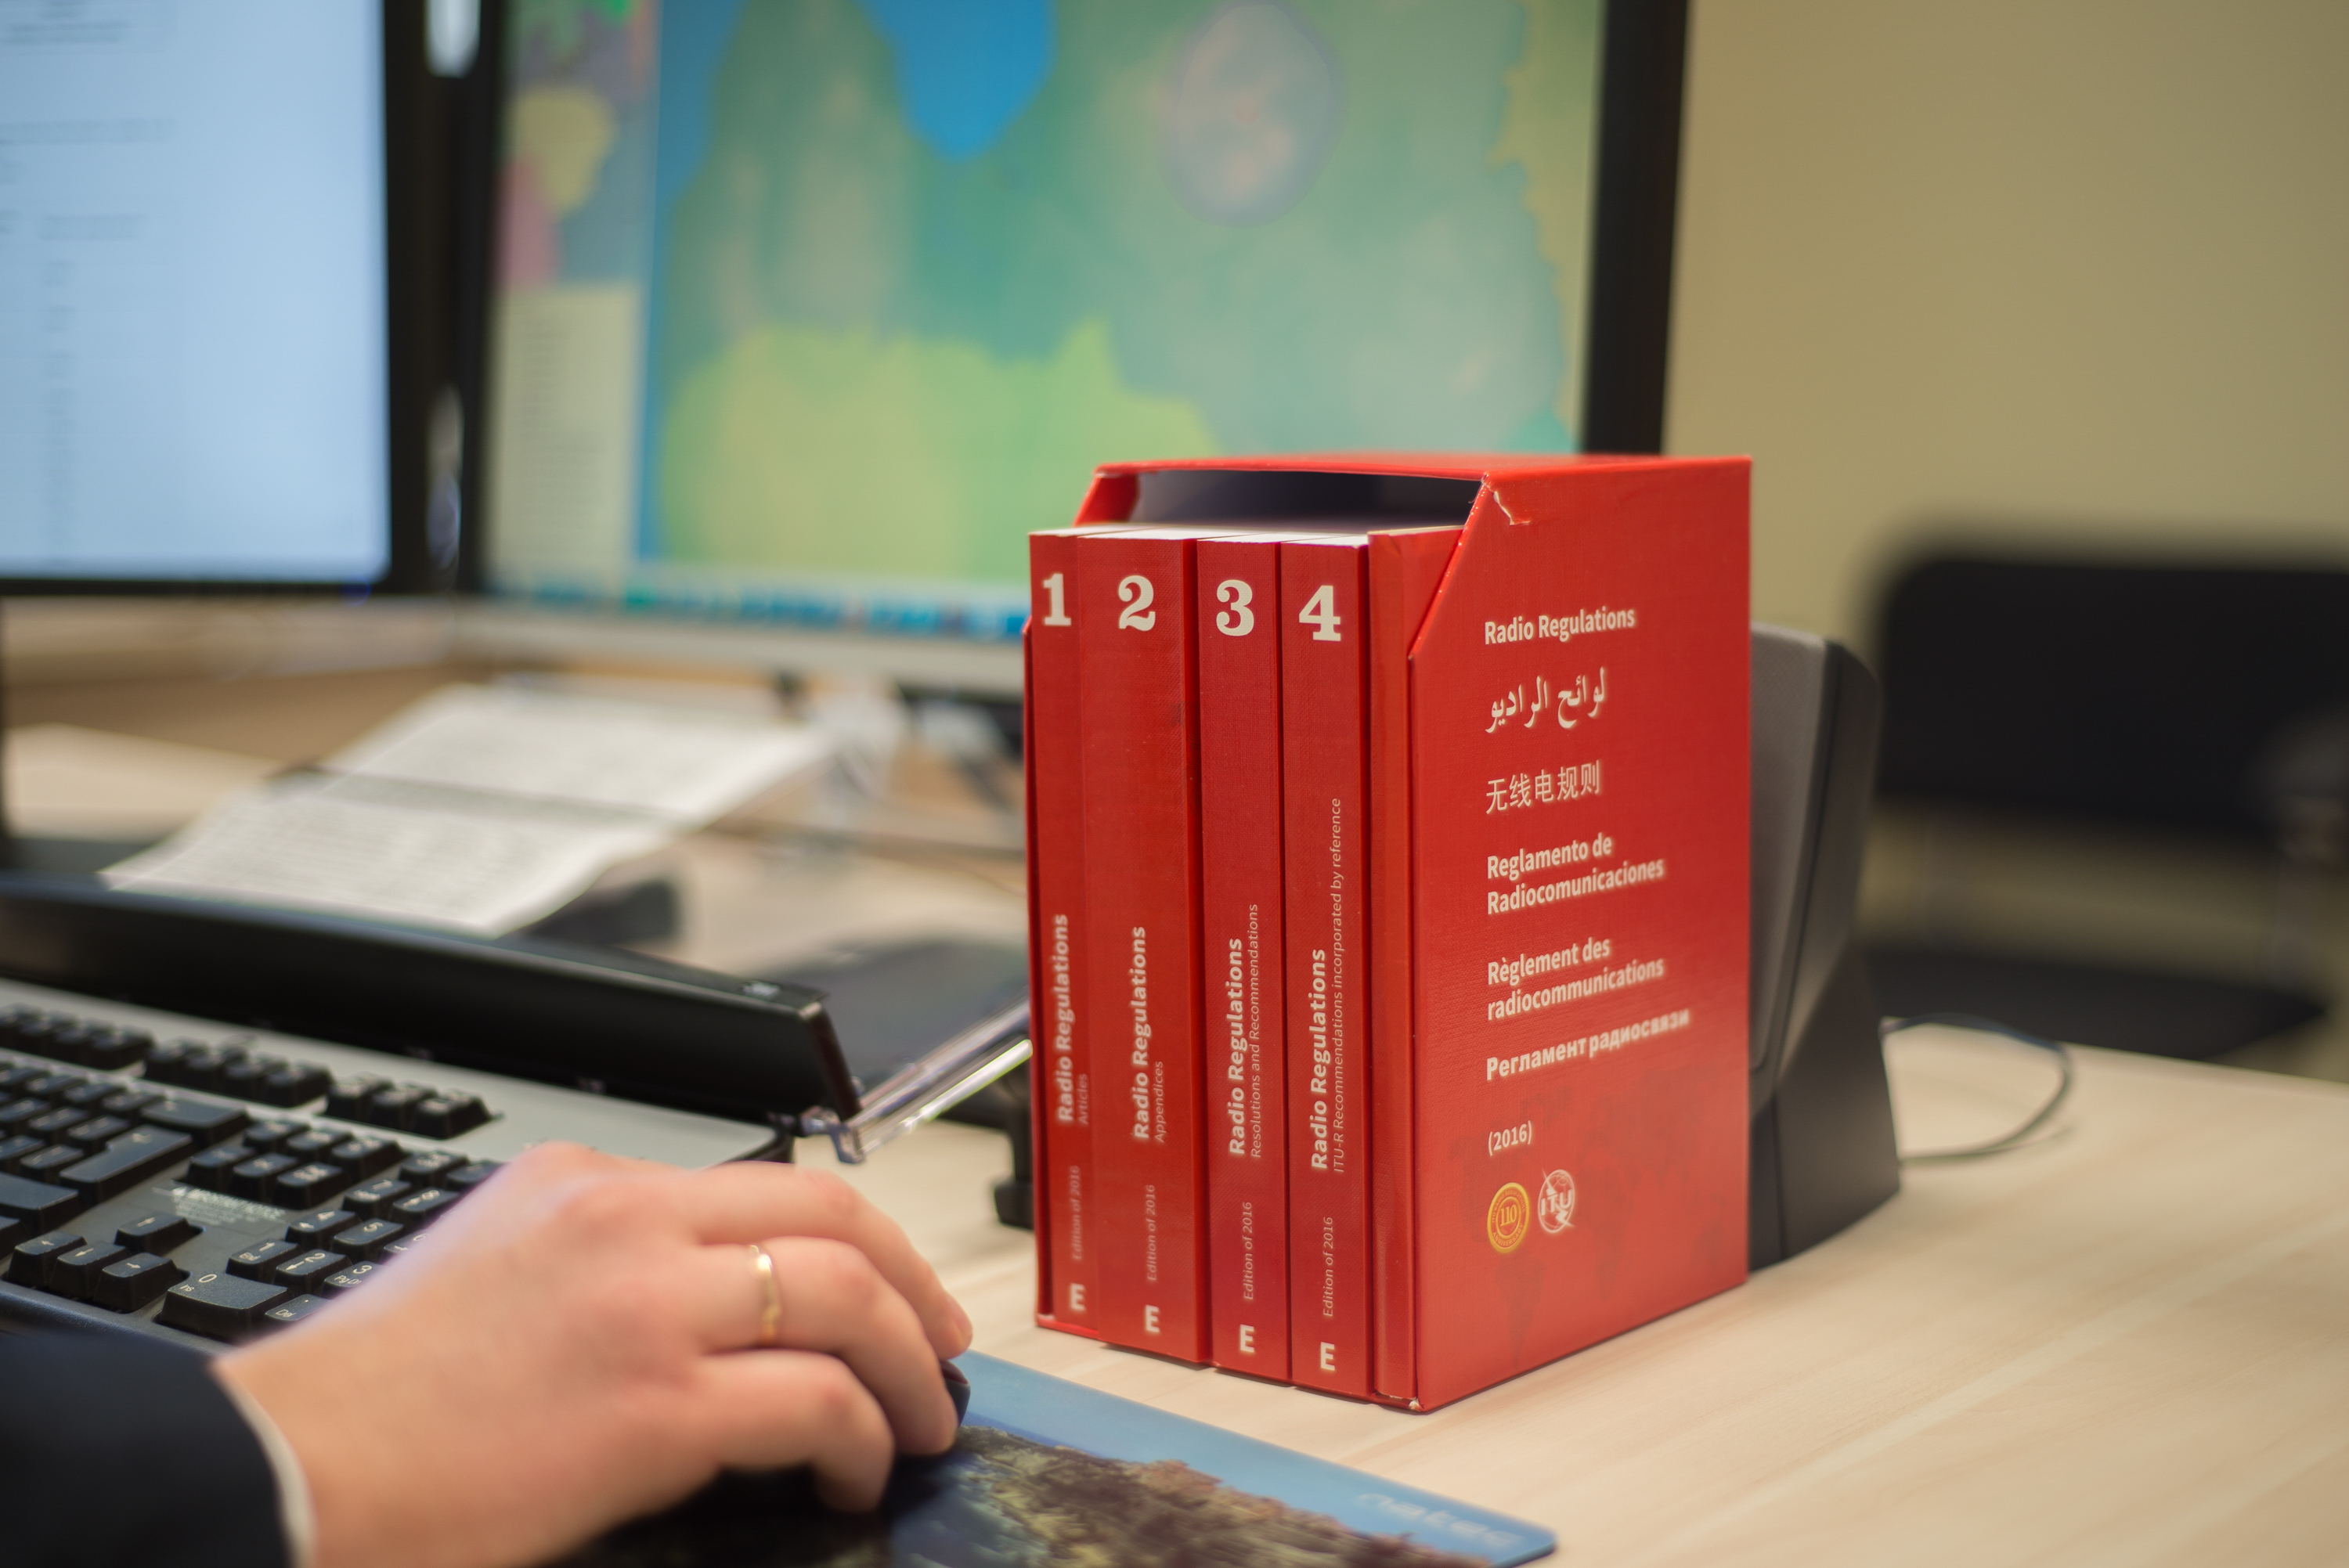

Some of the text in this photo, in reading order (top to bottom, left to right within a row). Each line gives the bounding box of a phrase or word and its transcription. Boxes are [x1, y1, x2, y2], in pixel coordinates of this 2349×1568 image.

[1043, 573, 1071, 626] 1
[1118, 575, 1156, 631] 2
[1216, 579, 1254, 636] 3
[1298, 585, 1341, 641] 4
[1485, 606, 1635, 644] Radio Regulations
[1485, 667, 1606, 733] لوائح الراديو
[1485, 760, 1600, 814] 无线电规则
[1488, 832, 1612, 881] Reglamento de
[1488, 859, 1665, 914] Radiocomunicaciones
[1330, 798, 1344, 1173] ITU-R Recommendations incorporated by reference
[1488, 937, 1610, 986] Règlement des
[1488, 958, 1665, 1020] radiocommunications
[1052, 914, 1074, 1121] Radio Regulations
[1130, 926, 1151, 1138] Radio Regulations
[1247, 904, 1261, 1158] Resolutions and Recommendations
[1487, 1008, 1690, 1080] Регламент радиосвязи
[1225, 939, 1247, 1154] Radio Regulations
[1308, 950, 1330, 1169] Radio Regulations
[1077, 1072, 1088, 1125] Articles
[1153, 1061, 1166, 1143] Appendices
[1488, 1120, 1532, 1156] (2016)
[1070, 1165, 1080, 1196] 2016
[1541, 1188, 1572, 1216] ITU
[1072, 1214, 1082, 1261] Edition
[1146, 1184, 1157, 1281] Edition of 2016
[1500, 1204, 1517, 1227] 110
[305, 1253, 326, 1263] 2
[353, 1265, 373, 1274] 3
[1243, 1202, 1253, 1300] Edition of 2016
[1323, 1217, 1333, 1317] Edition of 2016
[199, 1274, 217, 1283] 0
[1070, 1282, 1086, 1312] E
[276, 1309, 297, 1317] Del
[1144, 1304, 1160, 1332] E
[1239, 1324, 1254, 1353] E
[1320, 1341, 1335, 1371] E
